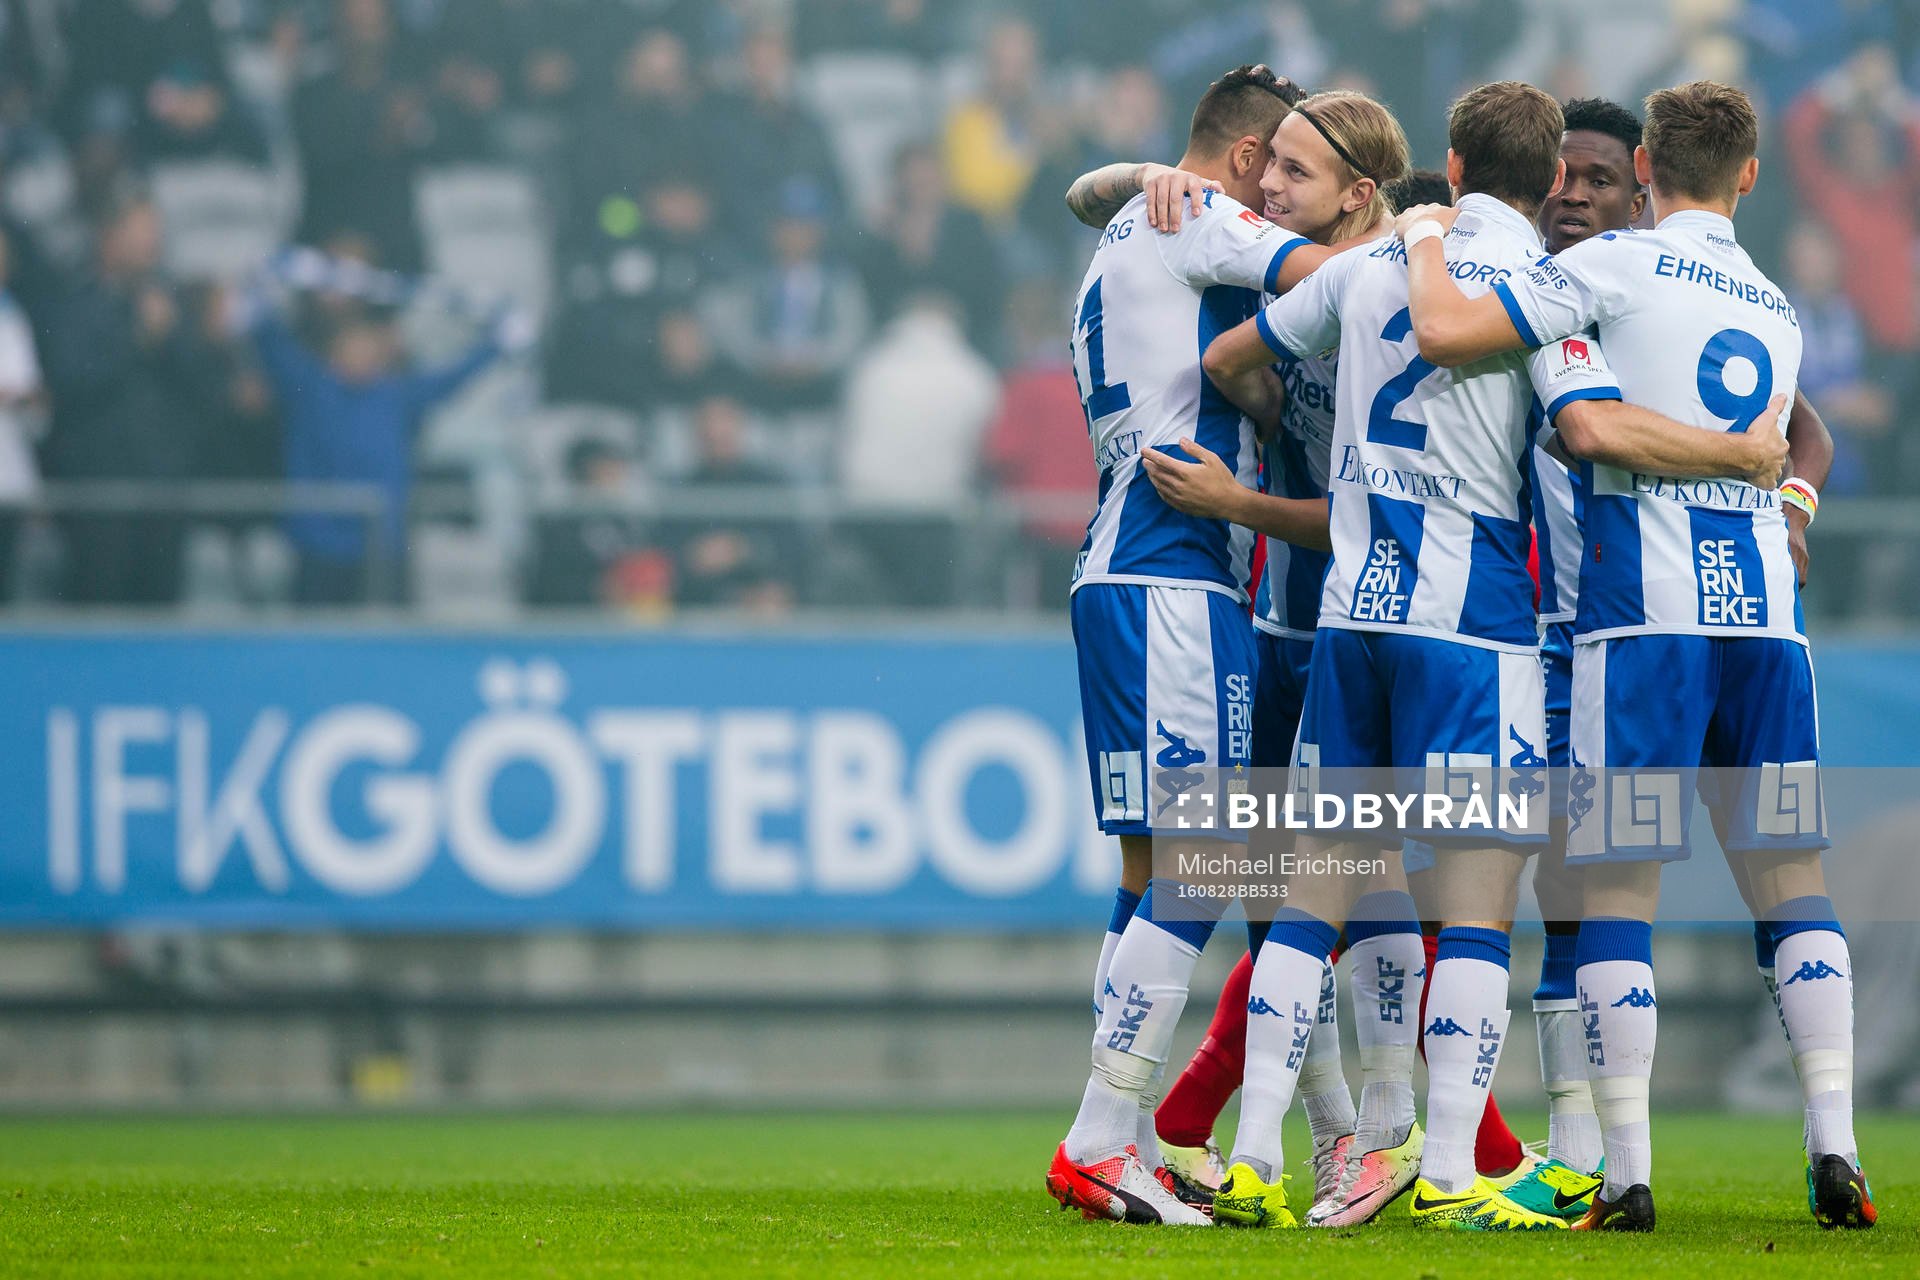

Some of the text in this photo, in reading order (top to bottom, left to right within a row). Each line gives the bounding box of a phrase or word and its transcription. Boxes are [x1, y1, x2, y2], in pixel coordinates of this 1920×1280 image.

[1367, 306, 1439, 452] 2
[1697, 328, 1773, 433] 9
[1371, 538, 1400, 566] SE
[1699, 540, 1737, 568] SE
[1359, 567, 1401, 593] RN
[1701, 568, 1745, 595] RN
[1353, 591, 1406, 621] EKE
[1704, 596, 1759, 625] EKE
[1226, 674, 1250, 702] SE
[1377, 956, 1405, 1025] SKF
[1107, 983, 1153, 1053] SKF
[1286, 1001, 1313, 1072] SKF
[1580, 985, 1606, 1066] SKF
[1472, 1017, 1501, 1088] SKF
